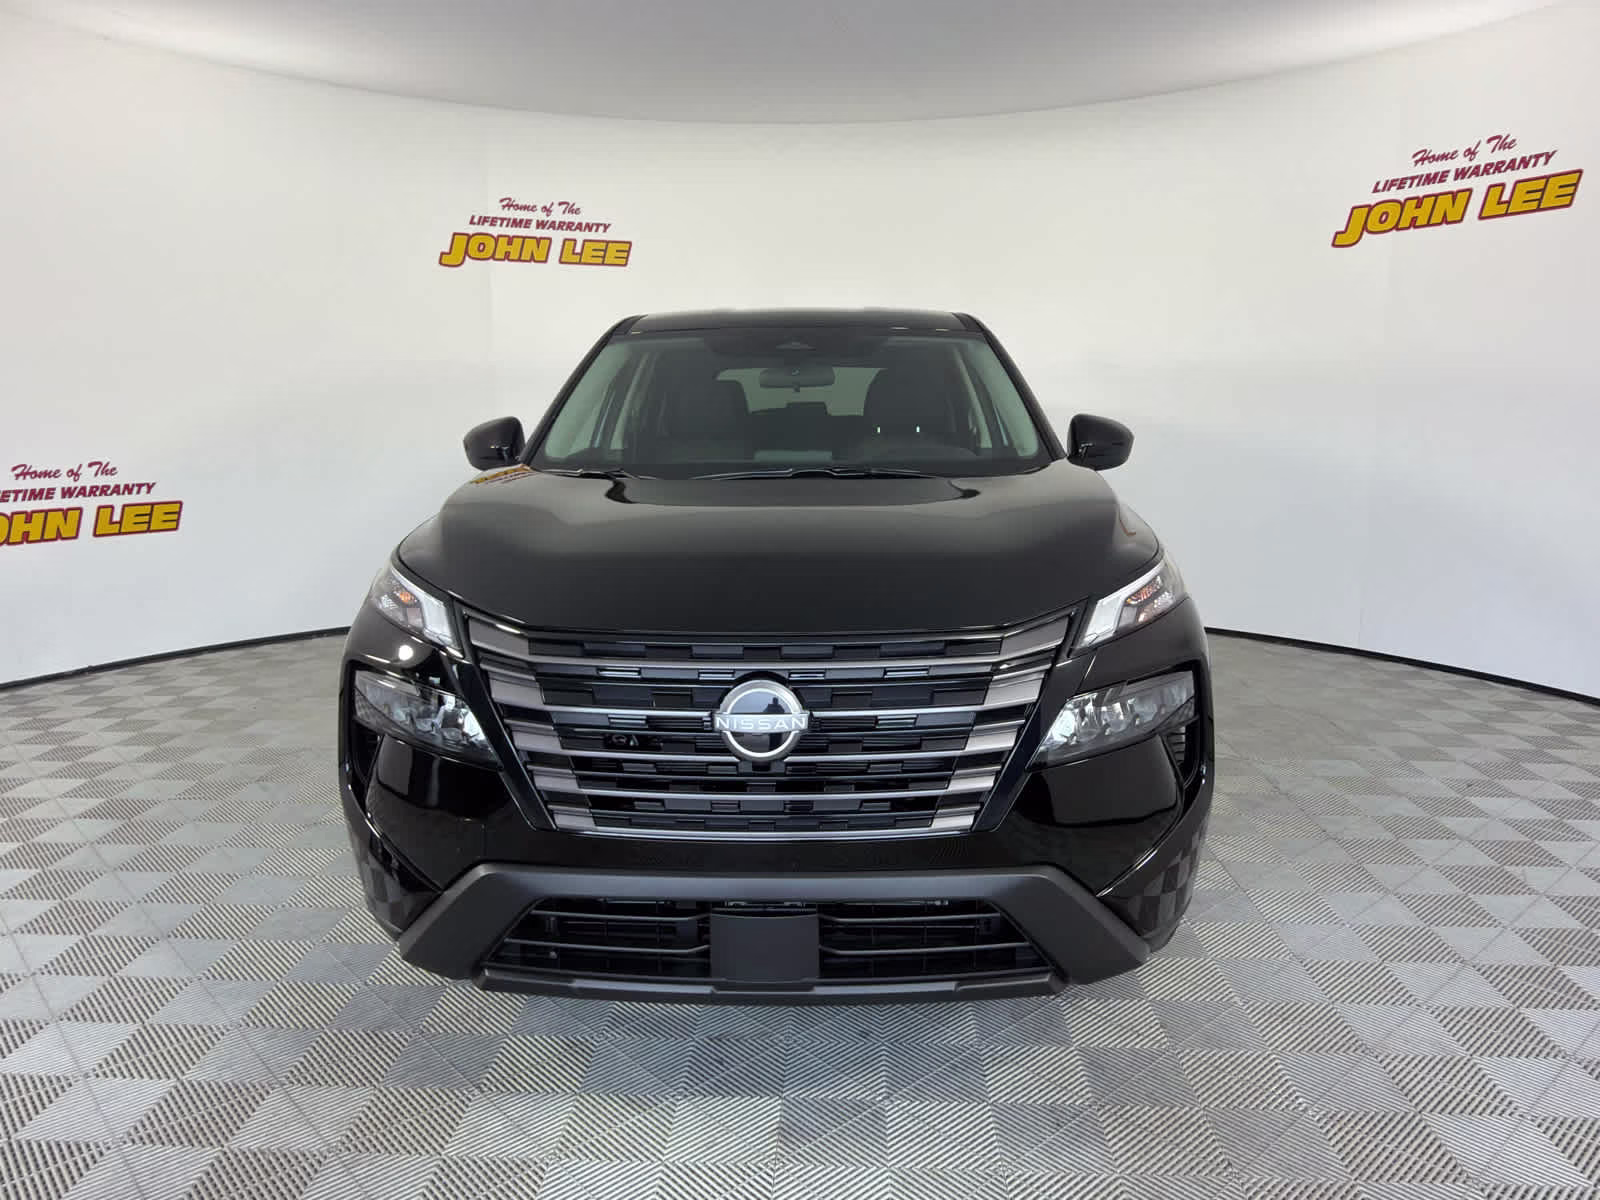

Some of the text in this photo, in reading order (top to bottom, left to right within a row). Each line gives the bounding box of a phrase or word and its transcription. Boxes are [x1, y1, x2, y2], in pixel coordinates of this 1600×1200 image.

[1412, 134, 1518, 167] Home of The
[1371, 150, 1557, 193] LIFETIME WARRANTY
[499, 197, 581, 216] Home of The
[1331, 169, 1583, 247] JOHN LEE
[469, 215, 611, 233] LIFETIME WARRANTY
[439, 232, 632, 267] JOHN LEE
[11, 461, 118, 482] Home of The
[0, 482, 156, 503] ETIME WARRANTY
[92, 501, 183, 537] LEE
[716, 716, 806, 730] NISSAN
